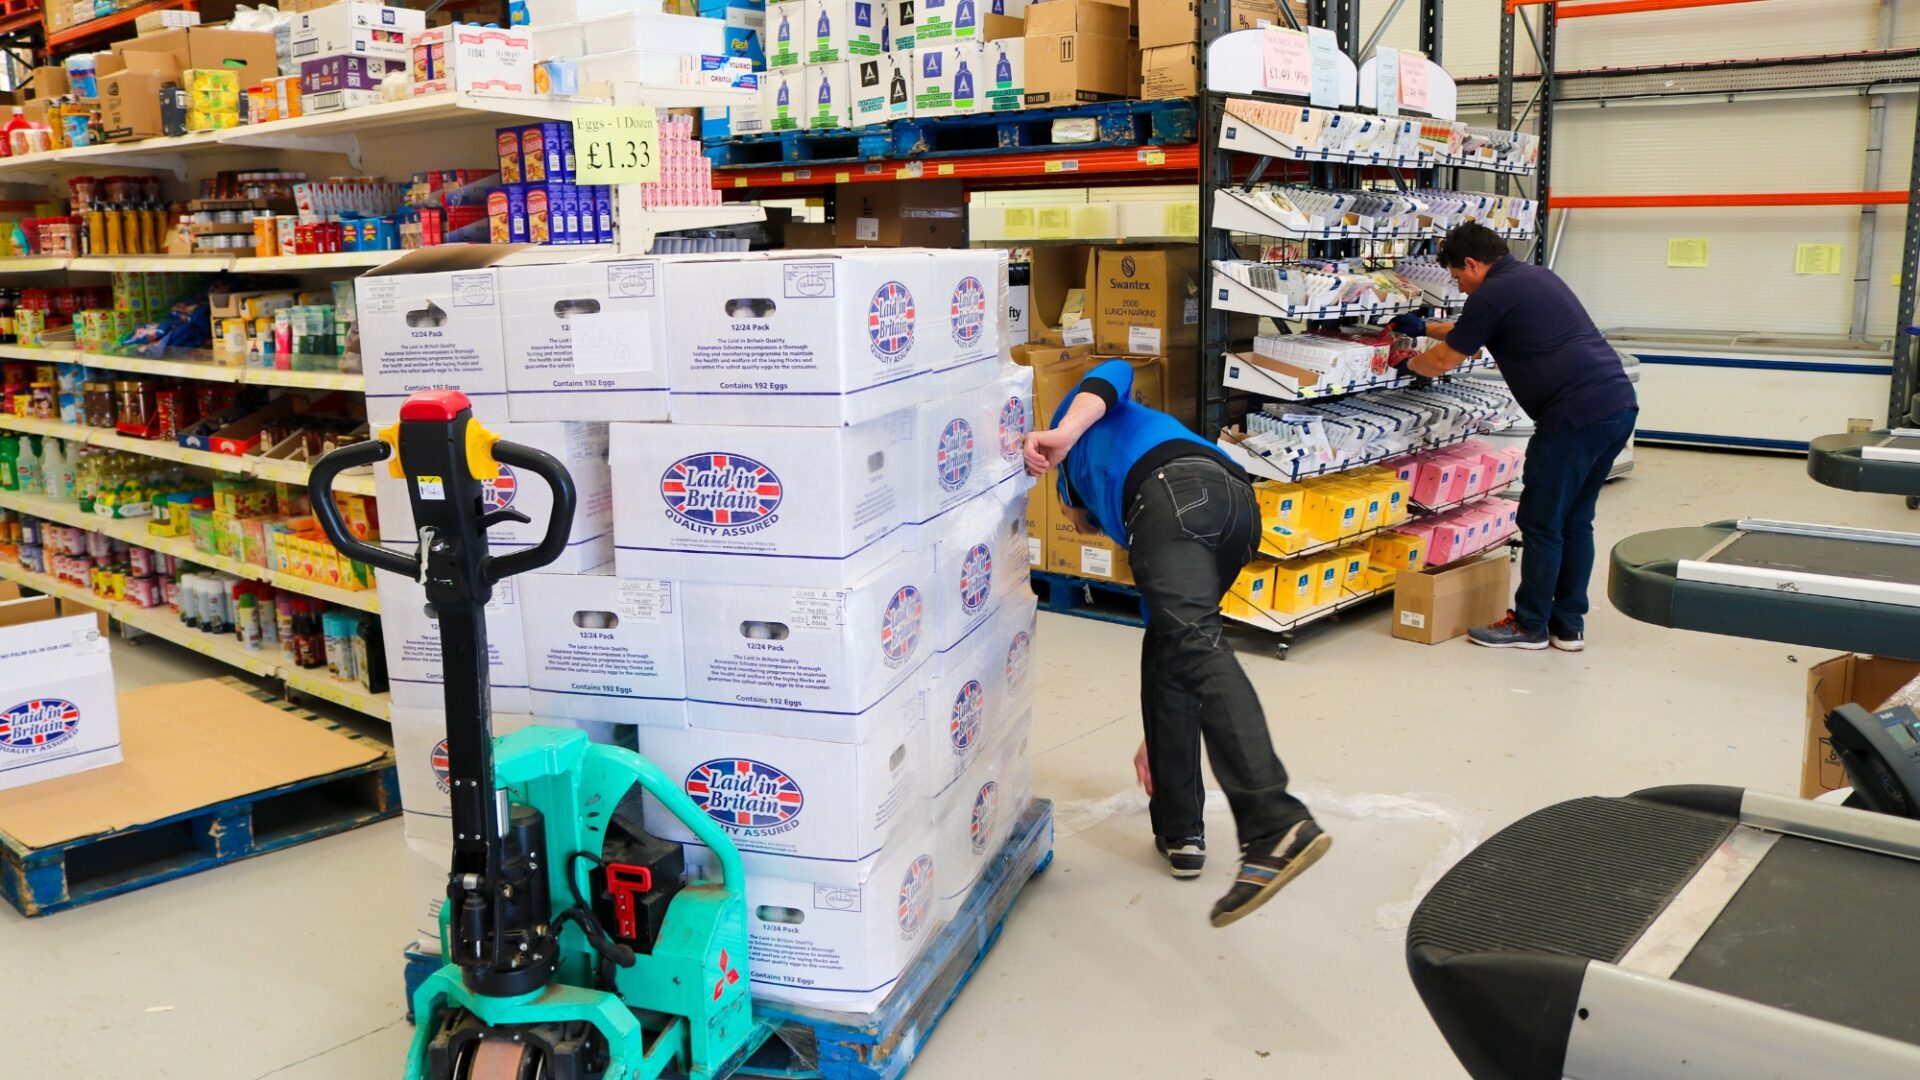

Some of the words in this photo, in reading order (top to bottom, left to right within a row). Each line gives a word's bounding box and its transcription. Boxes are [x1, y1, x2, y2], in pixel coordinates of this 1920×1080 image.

[576, 118, 605, 132] Eggs
[625, 116, 653, 129] Dozen
[587, 140, 650, 169] £1.33
[1110, 278, 1150, 290] Swantex
[879, 296, 897, 318] Laid
[897, 295, 906, 313] in
[1104, 303, 1127, 316] LUNCH
[1128, 305, 1156, 317] NAPKINS
[1122, 299, 1139, 308] 2000
[1008, 306, 1022, 323] fty
[879, 319, 907, 338] Britain
[598, 379, 615, 387] Eggs
[770, 382, 788, 390] Eggs
[686, 468, 731, 489] Laid
[735, 469, 756, 489] in
[685, 489, 758, 510] Britain
[664, 508, 718, 537] QUALITY
[721, 513, 780, 537] ASSURED
[747, 642, 766, 650] 12/24
[571, 683, 601, 691] Contains
[615, 686, 632, 694] Eggs
[736, 694, 768, 704] Contains
[769, 697, 782, 705] 192
[784, 699, 802, 707] Eggs
[12, 708, 43, 726] Laid
[48, 706, 62, 720] in
[12, 721, 64, 739] Britain
[39, 728, 79, 752] ASSURED
[710, 772, 753, 793] Laid
[758, 777, 778, 796] in
[710, 792, 778, 814] Britain
[744, 819, 800, 837] ASSURED
[762, 924, 782, 932] 12/24
[783, 926, 799, 934] Pack
[750, 970, 781, 981] Contains
[783, 975, 796, 983] 192
[797, 977, 814, 985] Eggs
